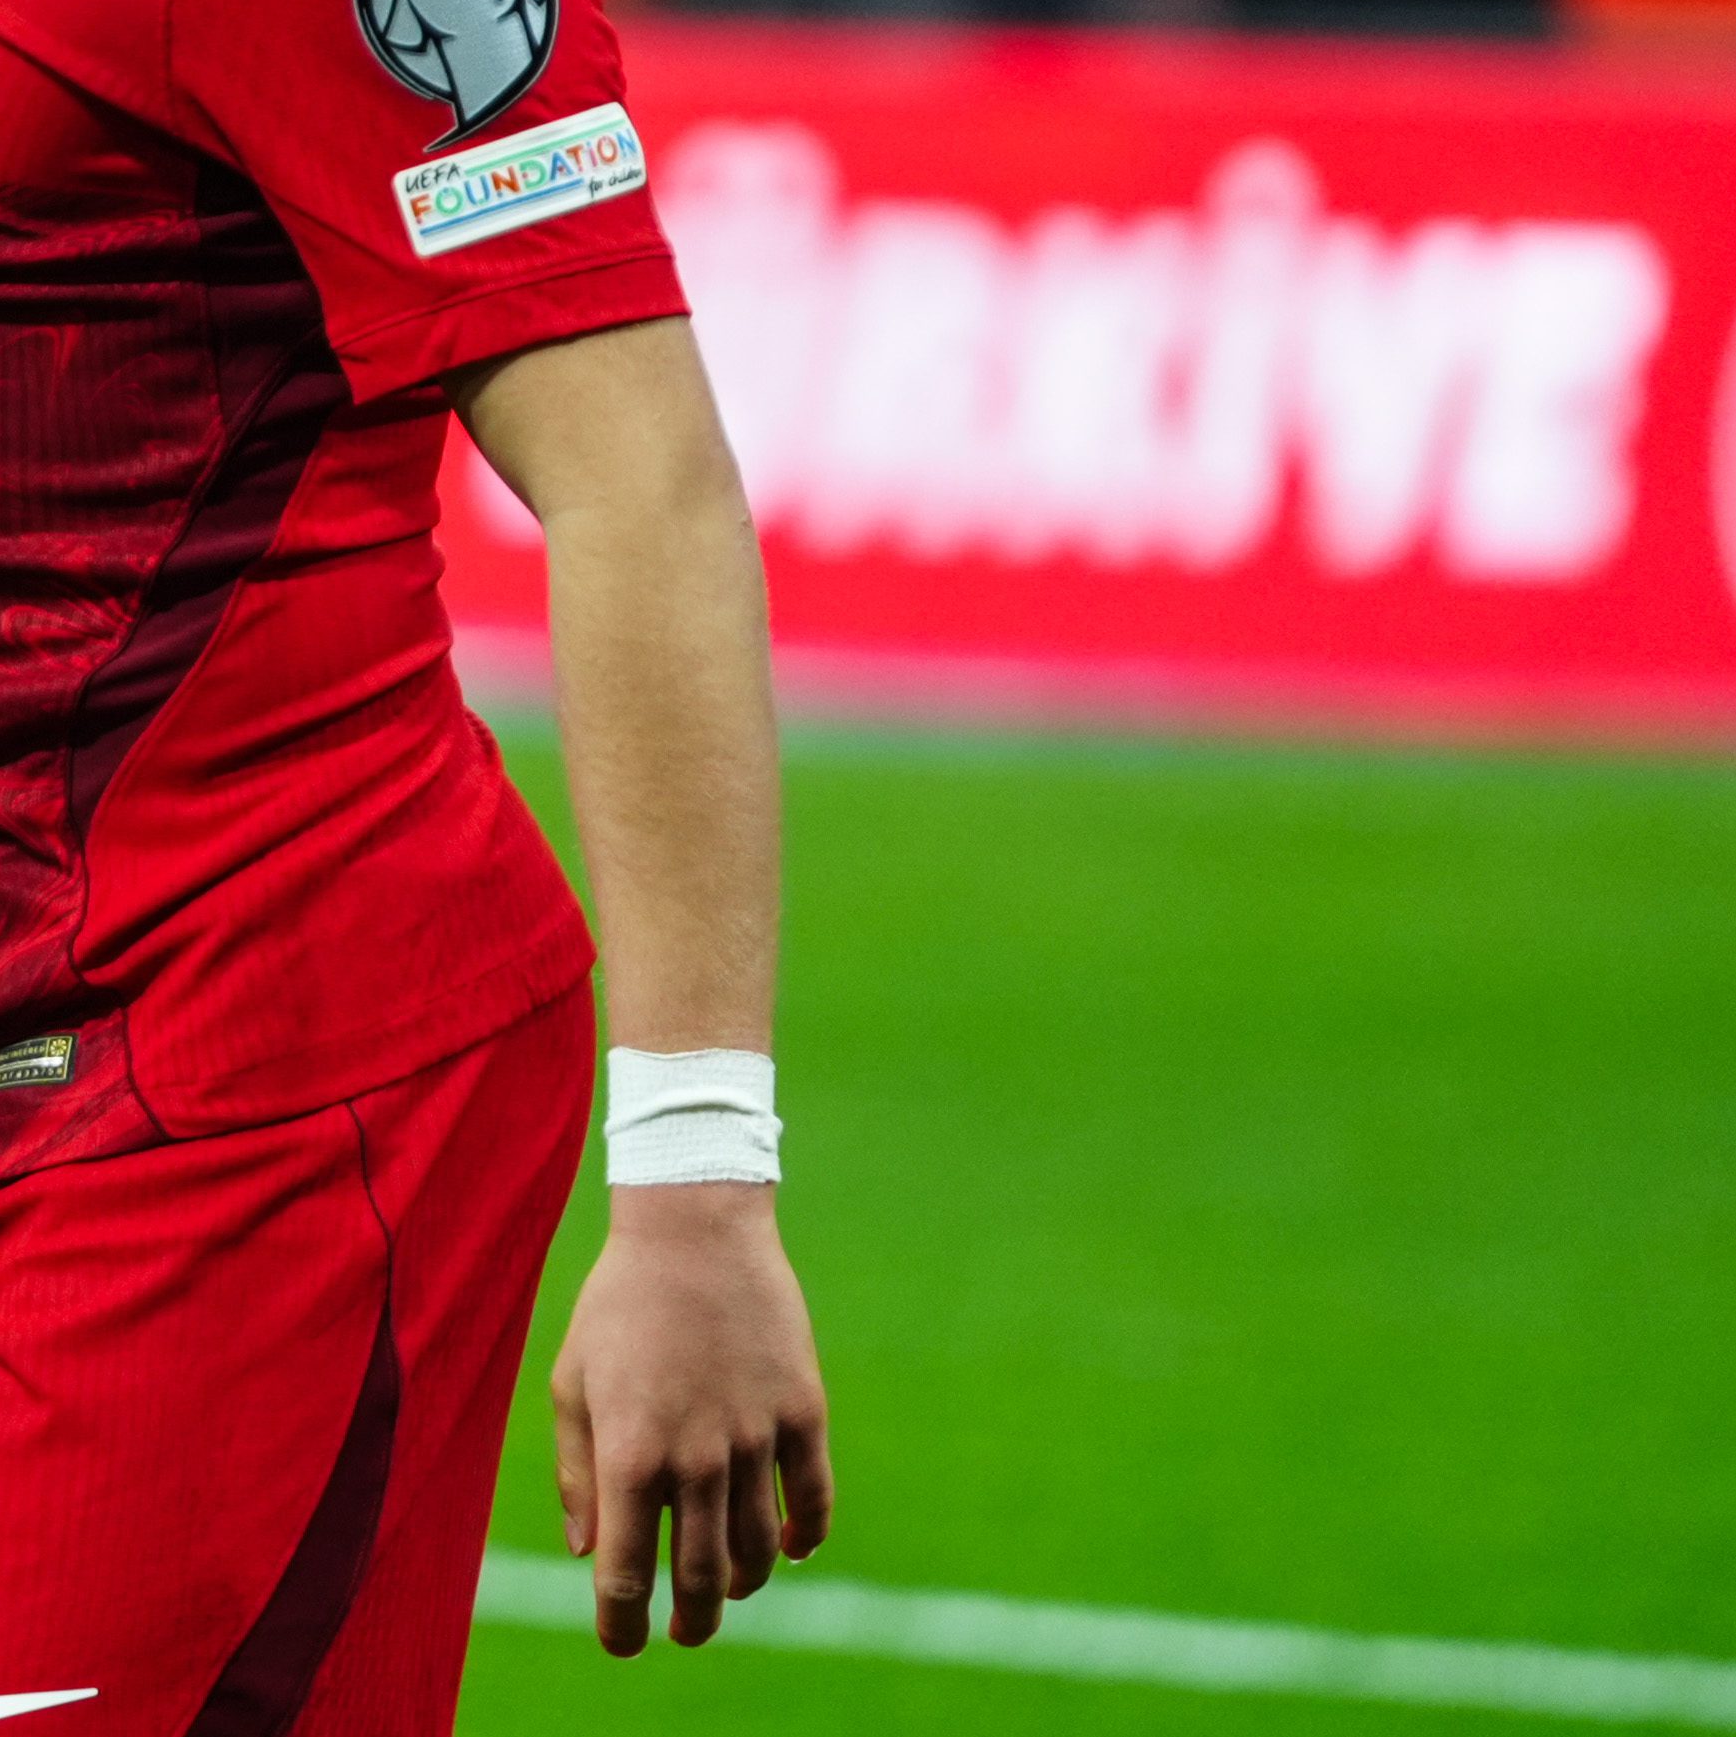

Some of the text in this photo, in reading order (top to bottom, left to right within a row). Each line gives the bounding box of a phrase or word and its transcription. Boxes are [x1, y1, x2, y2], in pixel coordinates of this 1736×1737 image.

[404, 162, 462, 194] UEFA
[409, 128, 639, 225] FOUNDATION
[587, 178, 608, 199] for
